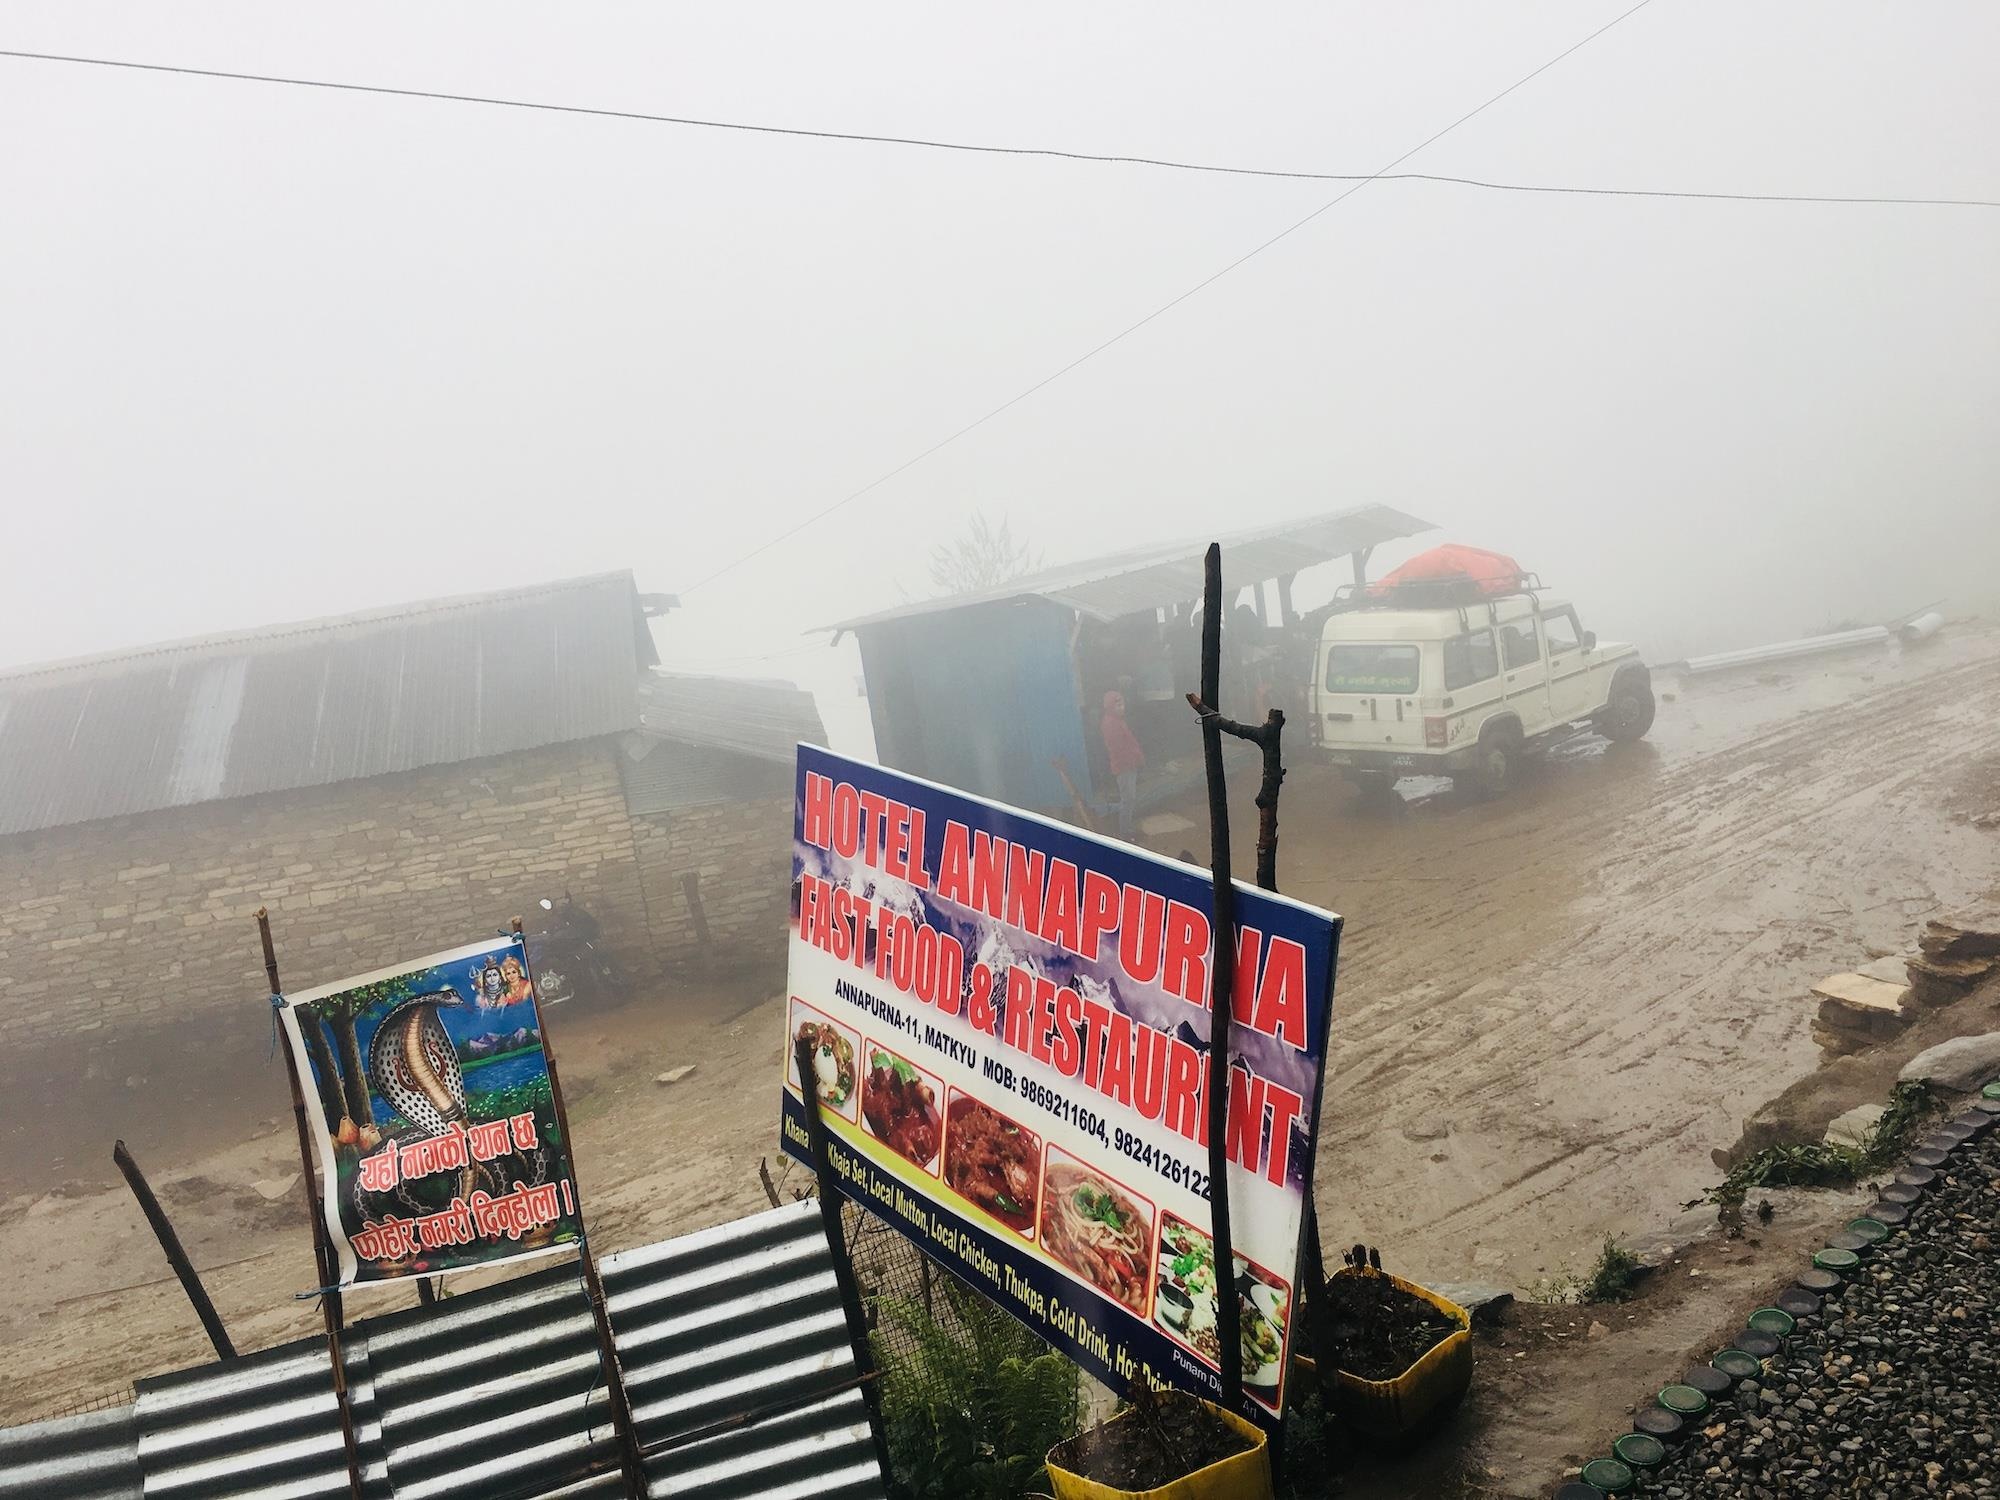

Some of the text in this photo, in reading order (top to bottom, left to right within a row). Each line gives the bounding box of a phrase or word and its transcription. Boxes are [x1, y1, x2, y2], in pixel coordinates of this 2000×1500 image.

[803, 770, 931, 891] HOTEL
[799, 871, 871, 970] FAST
[875, 906, 964, 1017] FOOD
[968, 962, 996, 1038] &
[834, 977, 922, 1045] ANNAPURNA-11,
[924, 1024, 977, 1070] MATKYU
[983, 1055, 1017, 1094] MOB:
[1020, 1075, 1110, 1150] 9869211604,
[359, 1111, 540, 1193] यहाँ नागको थान छ
[350, 1213, 421, 1261] फोहोर
[418, 1196, 476, 1250] नगरी
[784, 1113, 810, 1150] Khana
[826, 1141, 851, 1181] Khaja
[851, 1158, 869, 1195] Set,
[869, 1169, 895, 1208] Local
[895, 1186, 930, 1239] Mutton,
[930, 1212, 958, 1254] Local
[959, 1232, 1002, 1290] Chicken,
[1004, 1263, 1048, 1324] Thukpa,
[1049, 1297, 1075, 1339] Cold
[1078, 1316, 1113, 1373] Drink,
[1172, 1349, 1208, 1383] Punam
